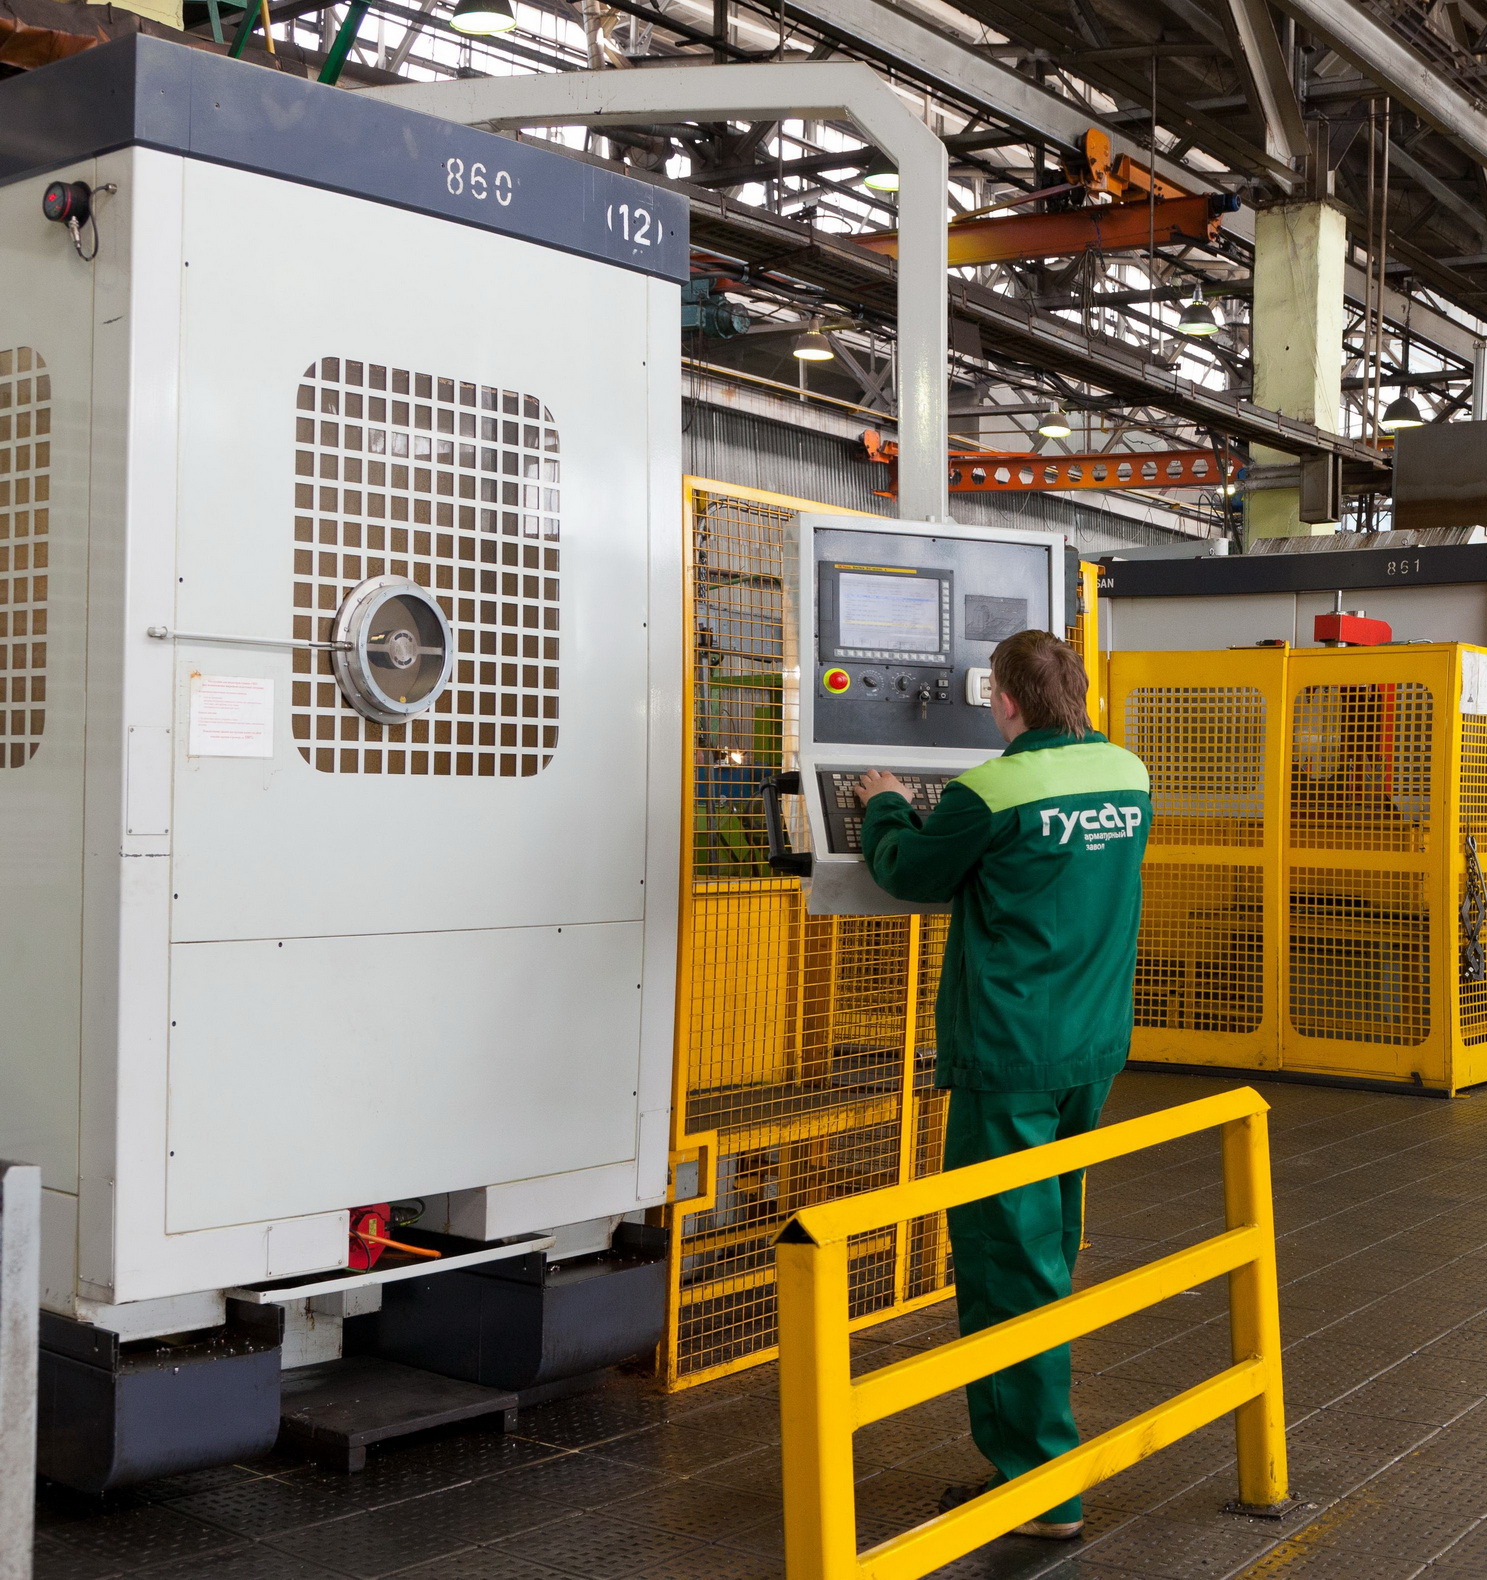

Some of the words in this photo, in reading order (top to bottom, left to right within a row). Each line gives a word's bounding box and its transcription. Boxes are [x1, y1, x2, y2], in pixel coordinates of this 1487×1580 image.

[446, 157, 513, 207] 860
[606, 203, 664, 247] (12)
[1386, 558, 1421, 576] 861
[1040, 802, 1142, 845] Гусар
[1084, 829, 1126, 841] арматурный
